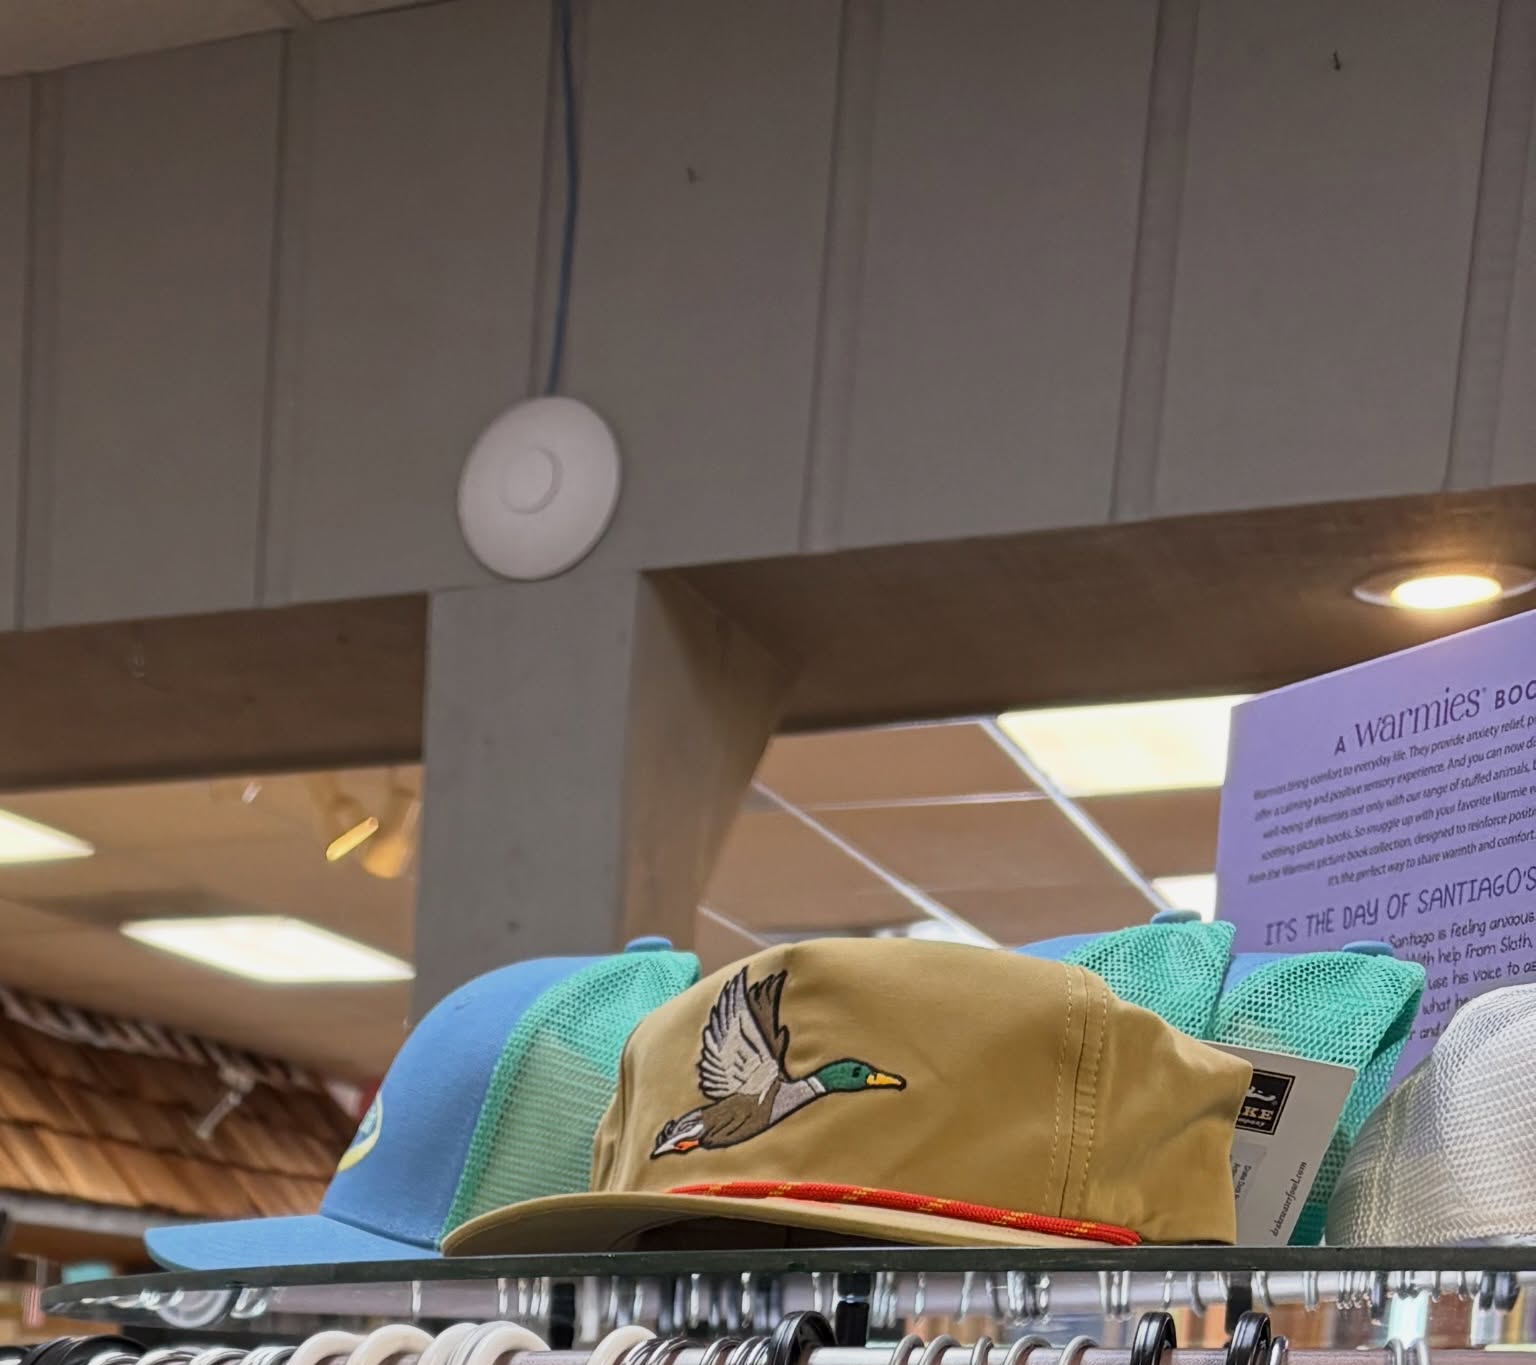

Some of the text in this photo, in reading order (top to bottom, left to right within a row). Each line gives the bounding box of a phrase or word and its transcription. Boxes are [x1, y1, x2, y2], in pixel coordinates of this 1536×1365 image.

[1333, 735, 1346, 756] A
[1410, 744, 1429, 759] They
[1431, 734, 1465, 754] provide
[1466, 722, 1500, 744] anxiety
[1447, 756, 1467, 770] And
[1468, 753, 1484, 768] you
[1485, 748, 1502, 760] can
[1504, 741, 1525, 755] now
[1406, 791, 1421, 803] our
[1423, 783, 1448, 799] range
[1449, 777, 1460, 791] of
[1461, 770, 1491, 790] stuffed
[1402, 814, 1413, 828] up
[1415, 807, 1434, 823] with
[1436, 803, 1455, 821] your
[1457, 794, 1492, 812] favorite
[1493, 785, 1527, 803] Warmie
[1414, 825, 1454, 846] designed
[1456, 823, 1466, 835] to
[1468, 813, 1508, 832] reinforce
[1388, 860, 1405, 874] way
[1406, 857, 1416, 869] to
[1417, 851, 1441, 867] share
[1442, 843, 1477, 861] warmth
[1478, 837, 1496, 852] and
[1306, 907, 1335, 937] THE
[1343, 898, 1379, 930] DAY
[1386, 893, 1411, 921] OF
[1438, 929, 1447, 941] is
[1450, 917, 1487, 938] feeling
[1438, 946, 1462, 966] help
[1465, 943, 1497, 960] from
[1427, 976, 1448, 991] use
[1452, 969, 1470, 985] his
[1473, 966, 1503, 982] voice
[1507, 960, 1520, 976] to
[1421, 995, 1452, 1015] what
[1419, 1021, 1441, 1039] and
